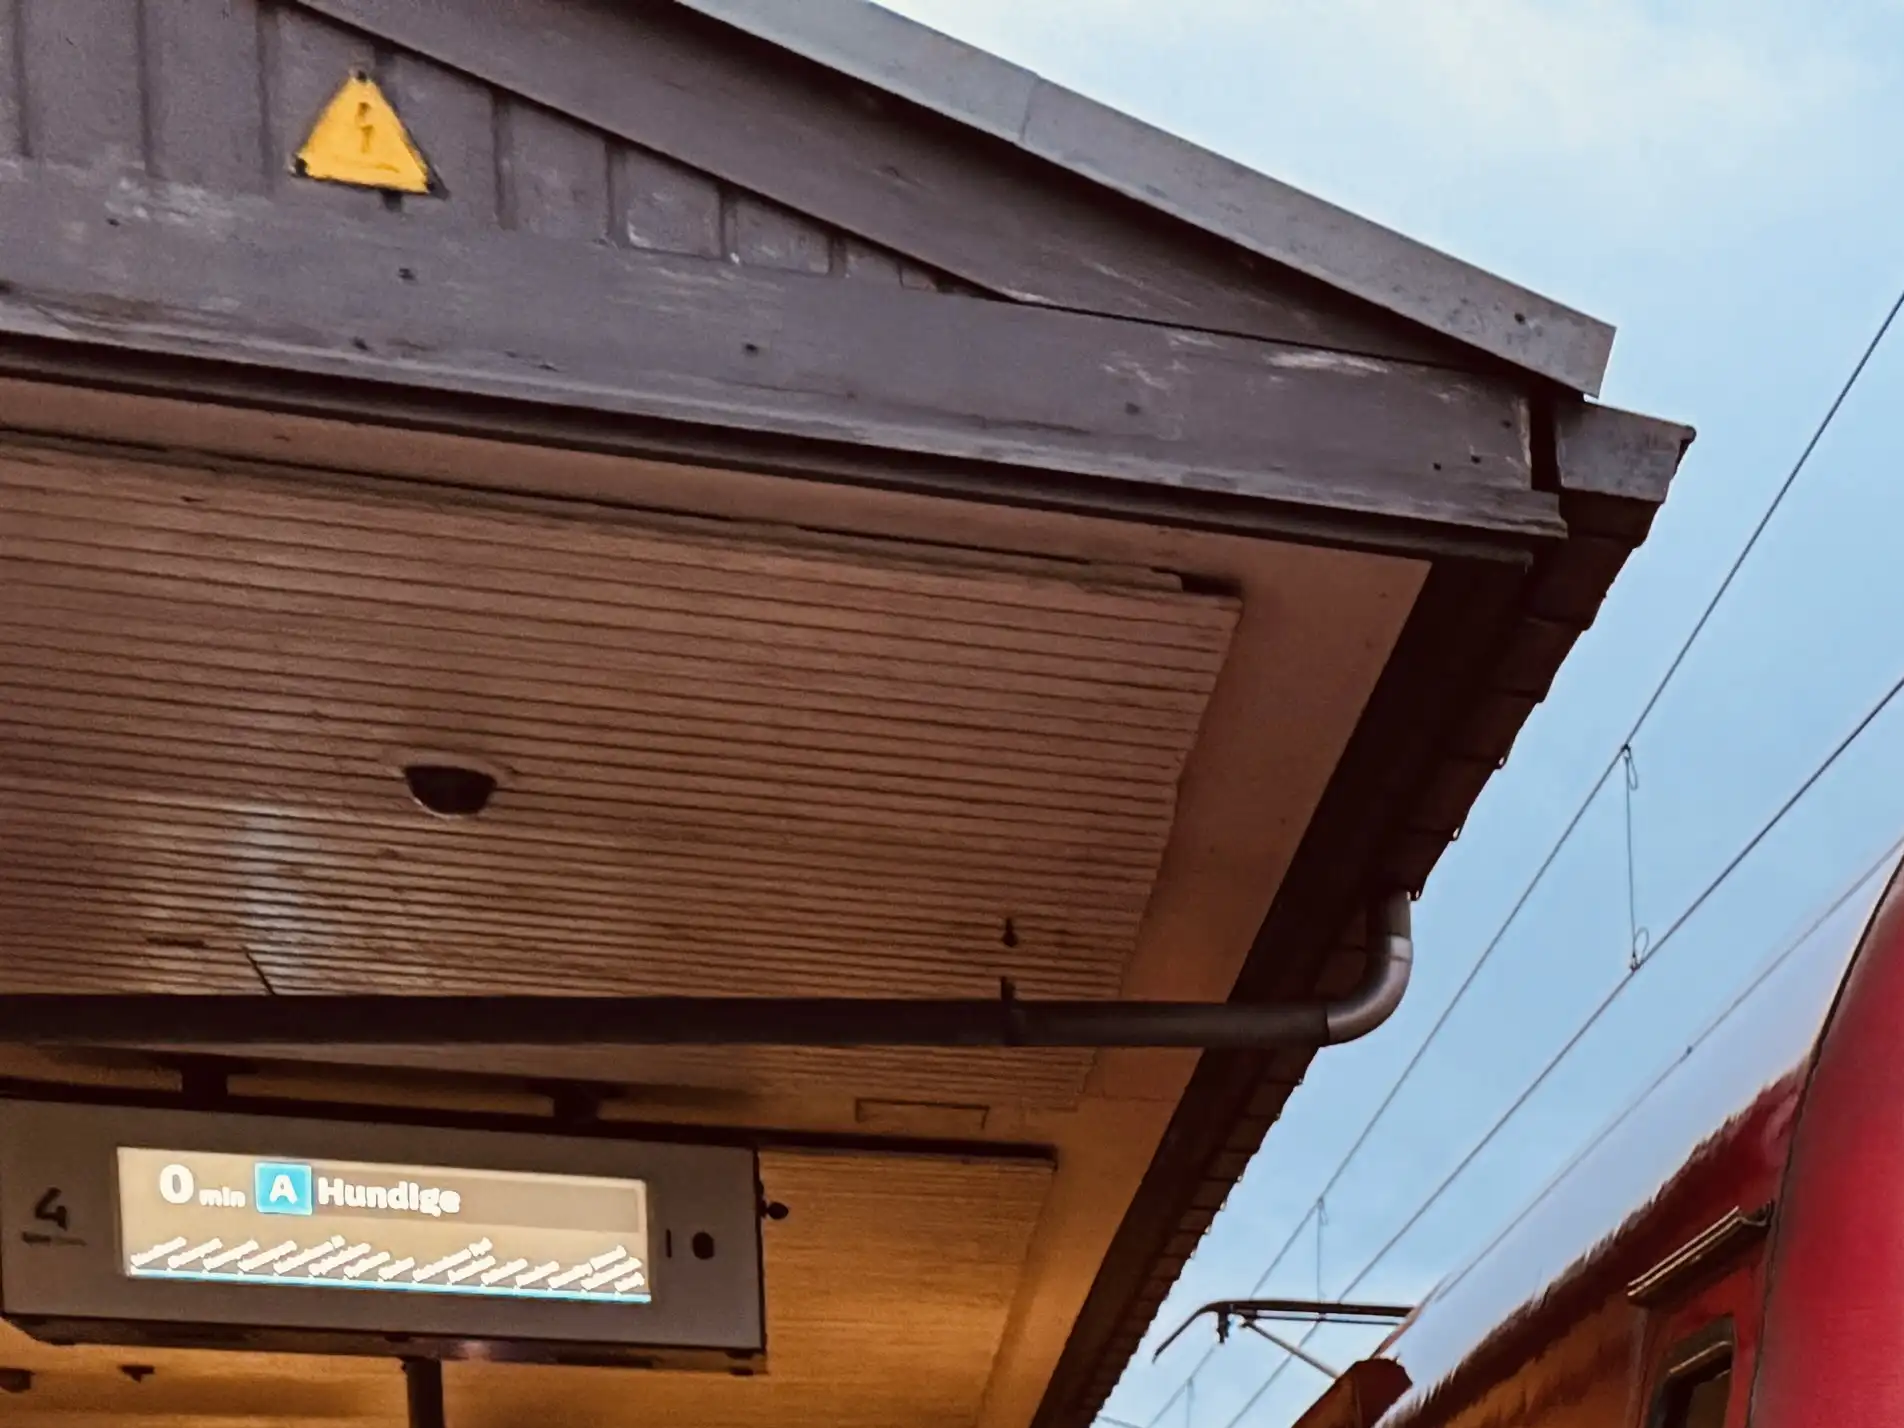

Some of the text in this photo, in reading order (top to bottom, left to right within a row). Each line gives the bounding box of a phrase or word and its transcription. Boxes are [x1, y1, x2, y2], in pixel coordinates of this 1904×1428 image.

[159, 1163, 461, 1217] 0 min A Hundige
